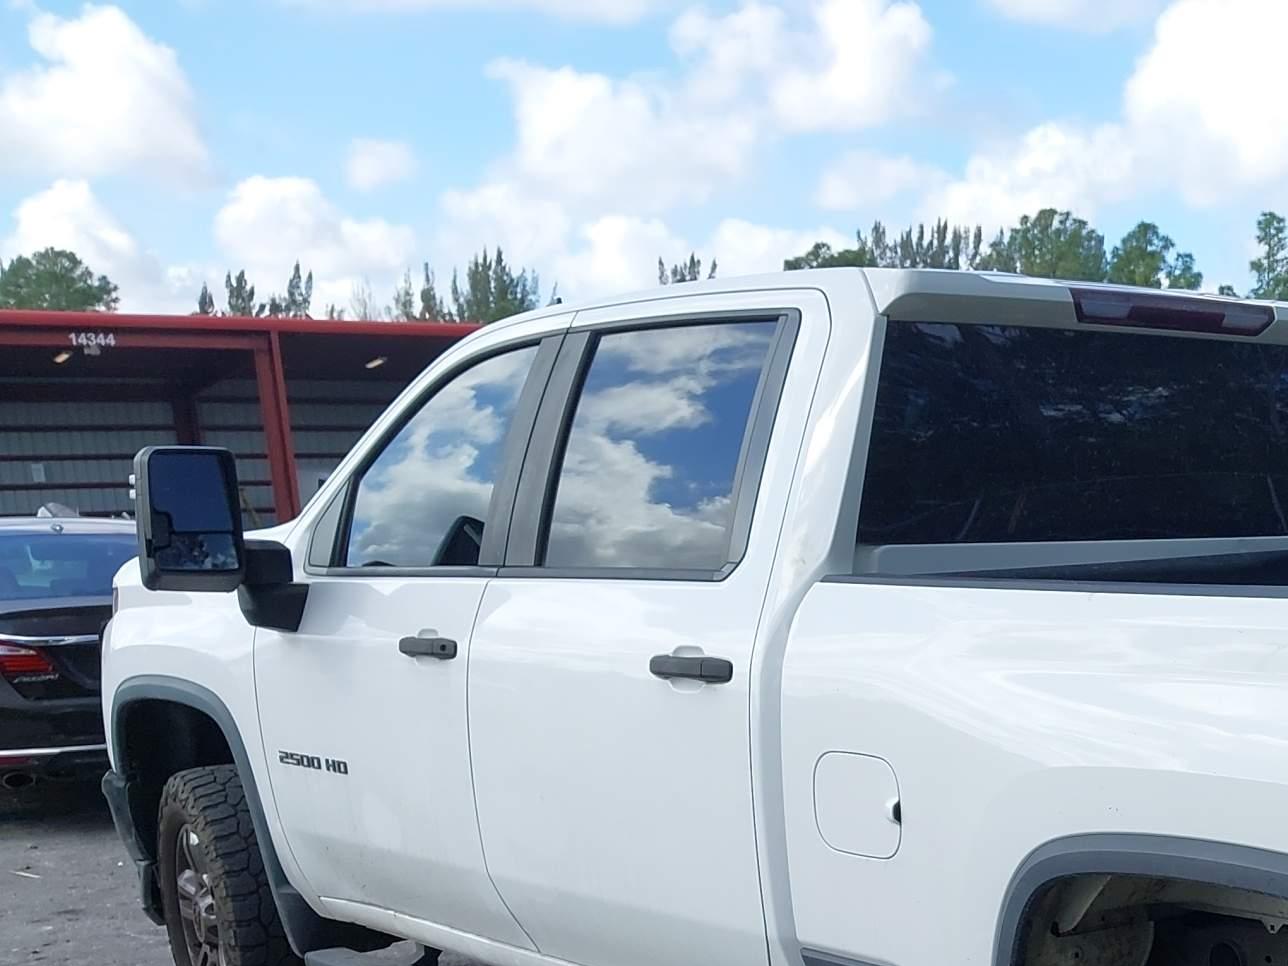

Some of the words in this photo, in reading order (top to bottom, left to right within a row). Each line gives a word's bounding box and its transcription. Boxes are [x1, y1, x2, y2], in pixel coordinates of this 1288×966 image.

[68, 332, 116, 347] 14344
[278, 750, 322, 770] 2500
[325, 758, 348, 775] HD
